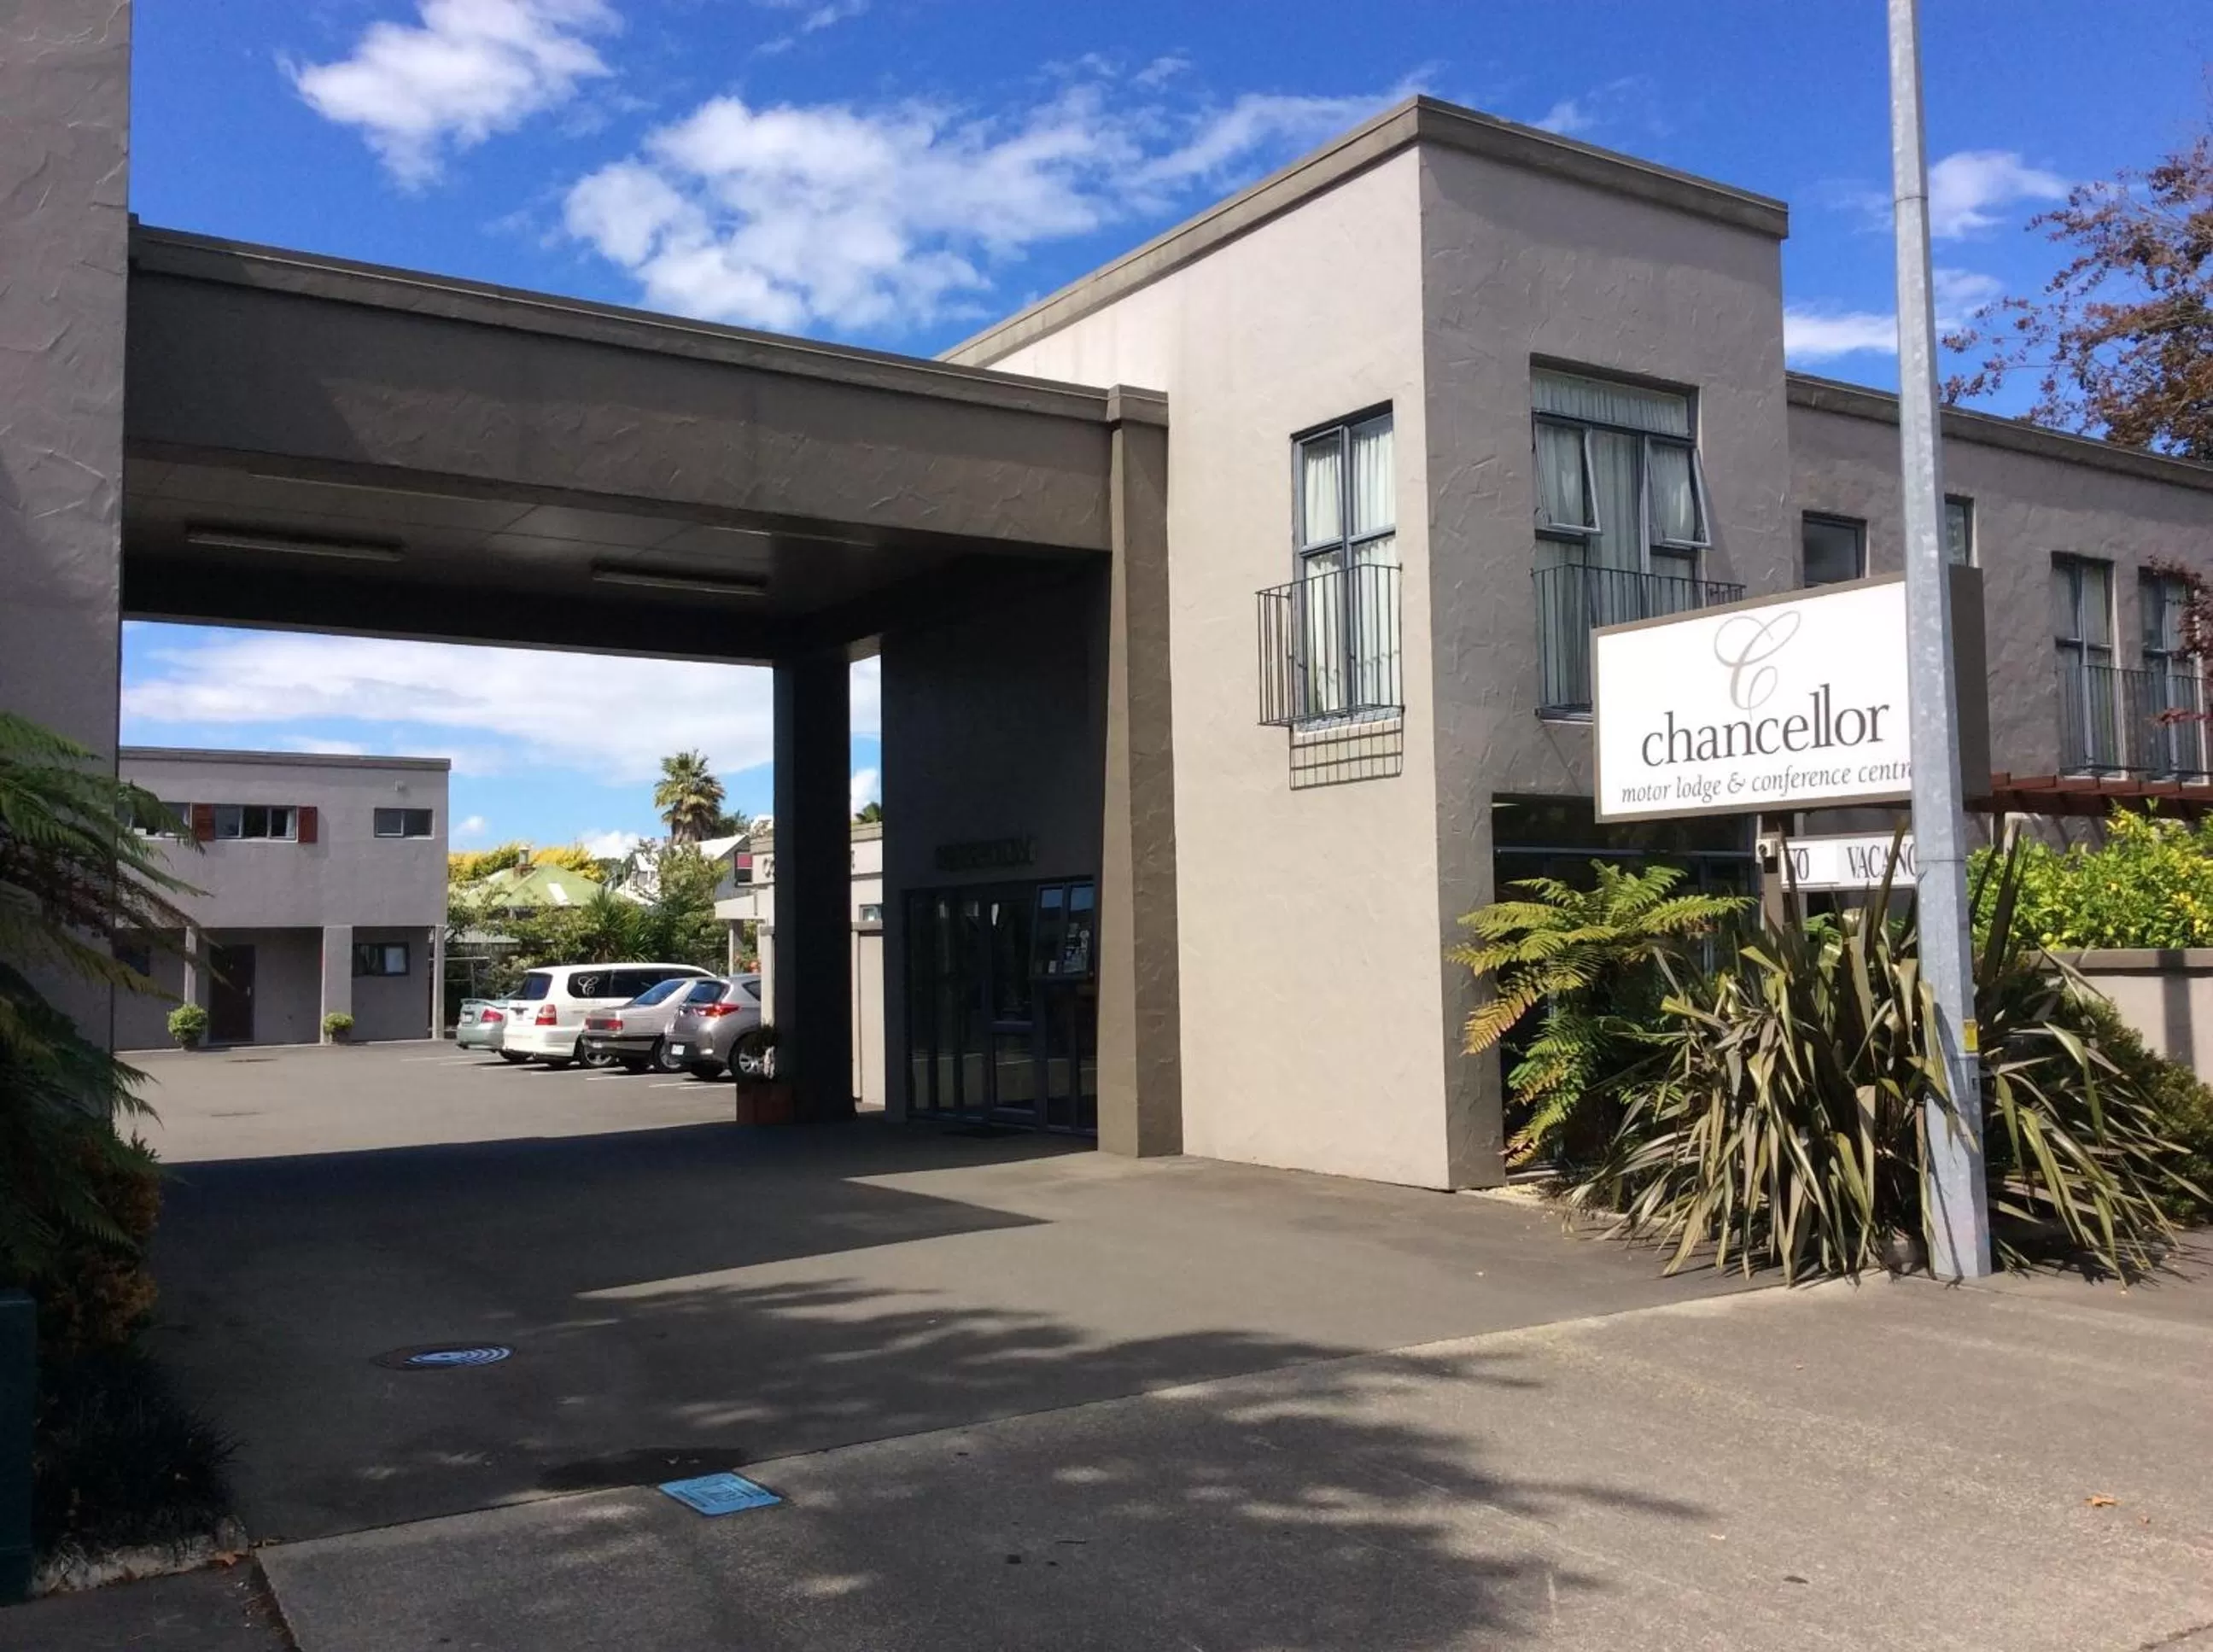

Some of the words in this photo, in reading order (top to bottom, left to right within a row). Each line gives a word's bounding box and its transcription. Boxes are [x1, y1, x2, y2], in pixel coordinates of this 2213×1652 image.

[1643, 684, 1889, 767] chancellor
[1622, 784, 1671, 803] motor
[1677, 775, 1721, 803] lodge
[1727, 772, 1746, 794] &
[1752, 765, 1851, 797] conference
